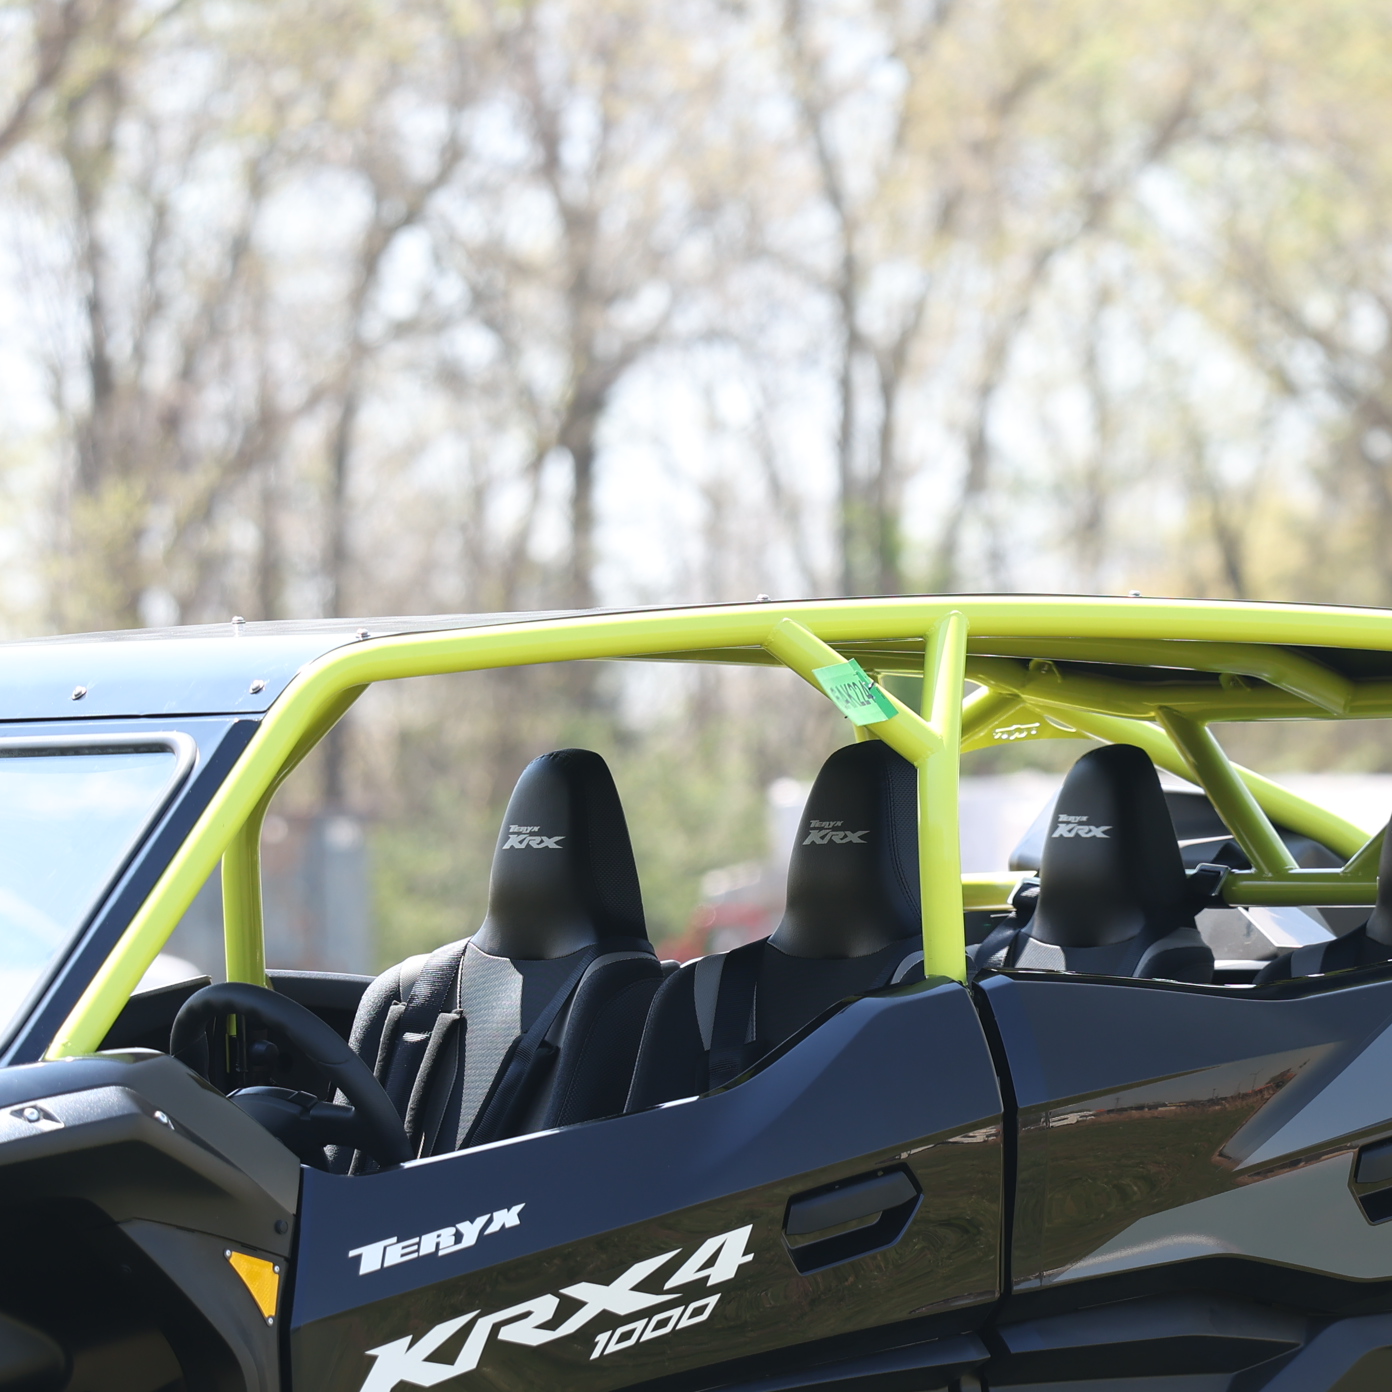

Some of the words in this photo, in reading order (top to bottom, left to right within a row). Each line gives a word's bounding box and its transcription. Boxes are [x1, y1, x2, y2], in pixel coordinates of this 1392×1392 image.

[802, 829, 871, 846] KRX
[1051, 823, 1114, 839] KRX
[502, 834, 567, 850] KRX
[589, 1293, 722, 1361] 1000
